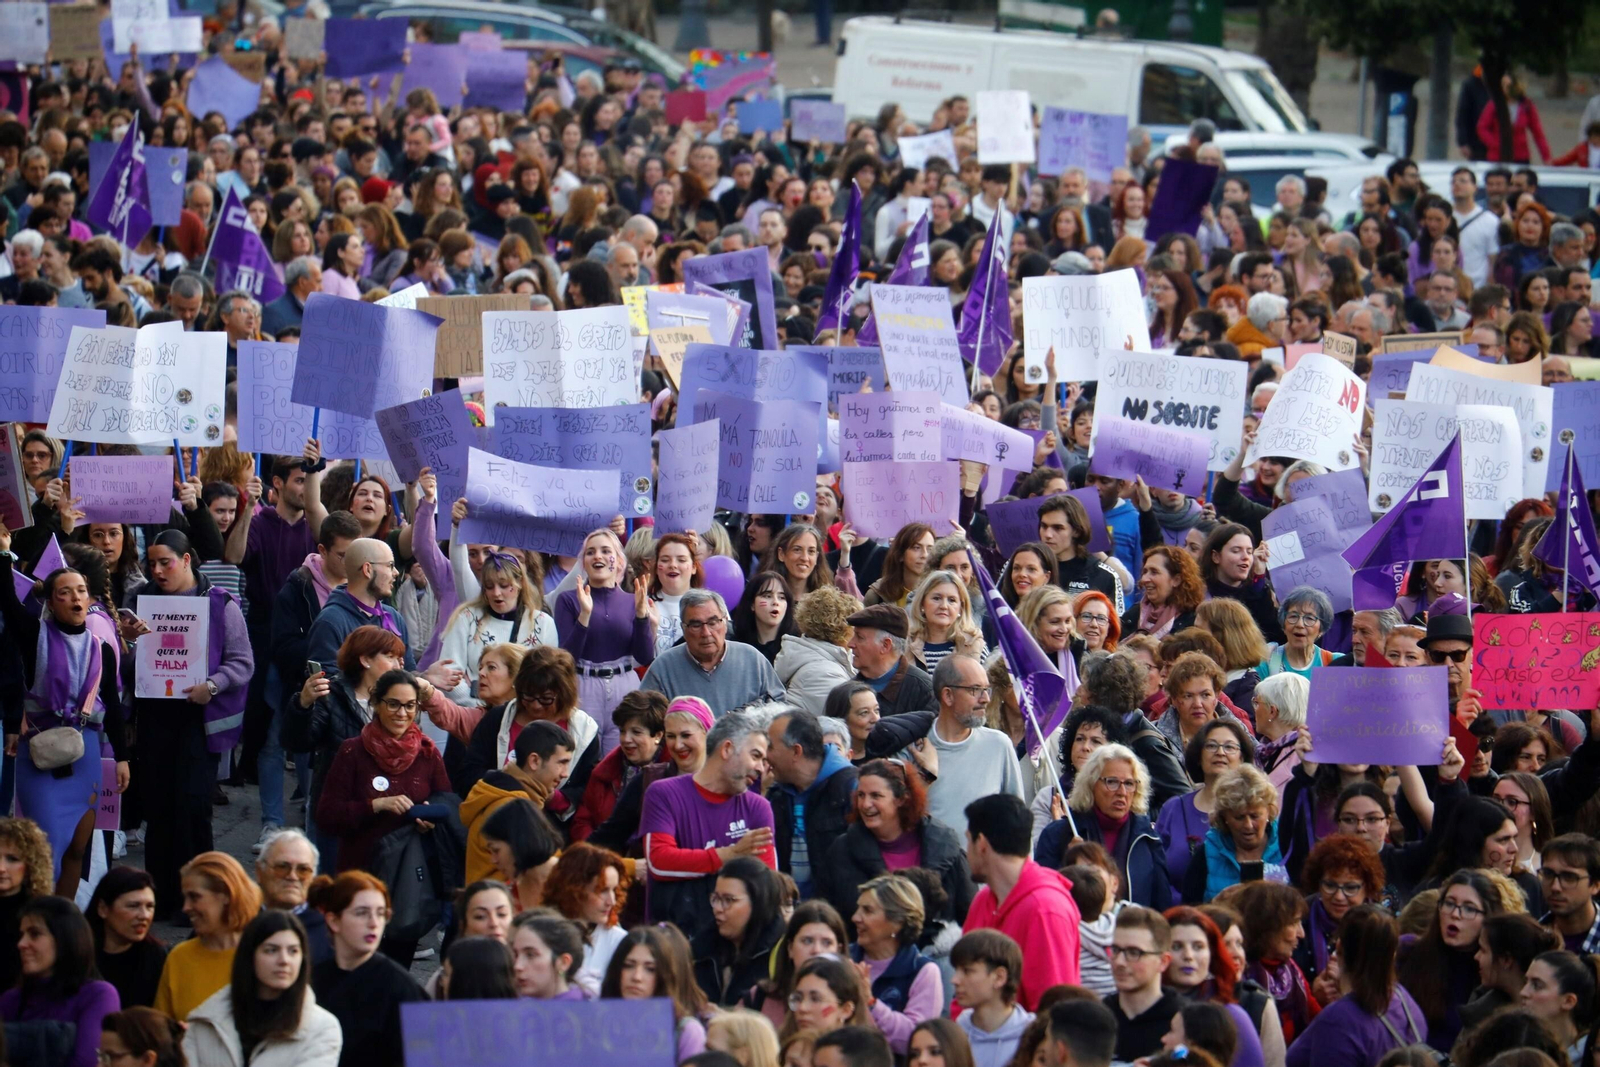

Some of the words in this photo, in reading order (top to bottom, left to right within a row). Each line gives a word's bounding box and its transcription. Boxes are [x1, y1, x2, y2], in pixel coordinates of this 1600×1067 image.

[0, 315, 65, 339] CANSAS
[491, 318, 546, 354] SOMOS
[578, 321, 628, 351] GRITO
[1028, 329, 1044, 351] EL
[156, 341, 180, 367] EN
[252, 347, 301, 381] PO
[490, 362, 517, 382] DE
[573, 357, 605, 381] QUE
[608, 357, 628, 384] YA
[1103, 356, 1156, 390] QUIEN
[1156, 357, 1180, 375] NO
[1154, 374, 1178, 391] SE
[141, 372, 175, 405] NO
[517, 386, 544, 408] NO
[1336, 378, 1361, 414] NO
[414, 395, 445, 417] VES
[847, 402, 870, 424] Hoy
[878, 400, 921, 421] gritamos
[925, 406, 936, 415] en
[1121, 396, 1149, 421] NO
[1150, 395, 1222, 431] SIENTE
[252, 418, 305, 453] POR
[844, 418, 859, 431] las
[863, 418, 895, 431] calles
[901, 428, 924, 442] pero
[971, 423, 985, 436] NO
[1384, 407, 1428, 440] NOS
[419, 429, 459, 455] PARTE
[946, 435, 957, 450] TU
[962, 439, 986, 455] CULPA
[1263, 427, 1318, 457] GUAPA
[601, 443, 624, 467] NO
[729, 452, 743, 470] NO
[752, 457, 766, 474] VOY
[771, 457, 804, 473] SOLA
[844, 449, 894, 463] luchamos
[897, 449, 916, 460] cada
[486, 460, 533, 489] Feliz
[544, 477, 566, 492] va
[584, 478, 596, 491] a
[908, 469, 917, 485] A
[1472, 456, 1512, 482] NOS
[75, 478, 85, 489] NO
[492, 485, 521, 500] ser
[752, 484, 778, 505] CALLE
[920, 490, 945, 515] NO
[1300, 528, 1327, 550] ESTOY
[1069, 581, 1089, 590] NASA
[1290, 563, 1322, 587] MÁS
[151, 613, 166, 622] TU
[165, 613, 199, 622] MENTE
[156, 624, 170, 634] ES
[1479, 615, 1543, 648] Con
[156, 648, 175, 658] QUE
[175, 648, 189, 657] MI
[154, 659, 189, 672] FALDA
